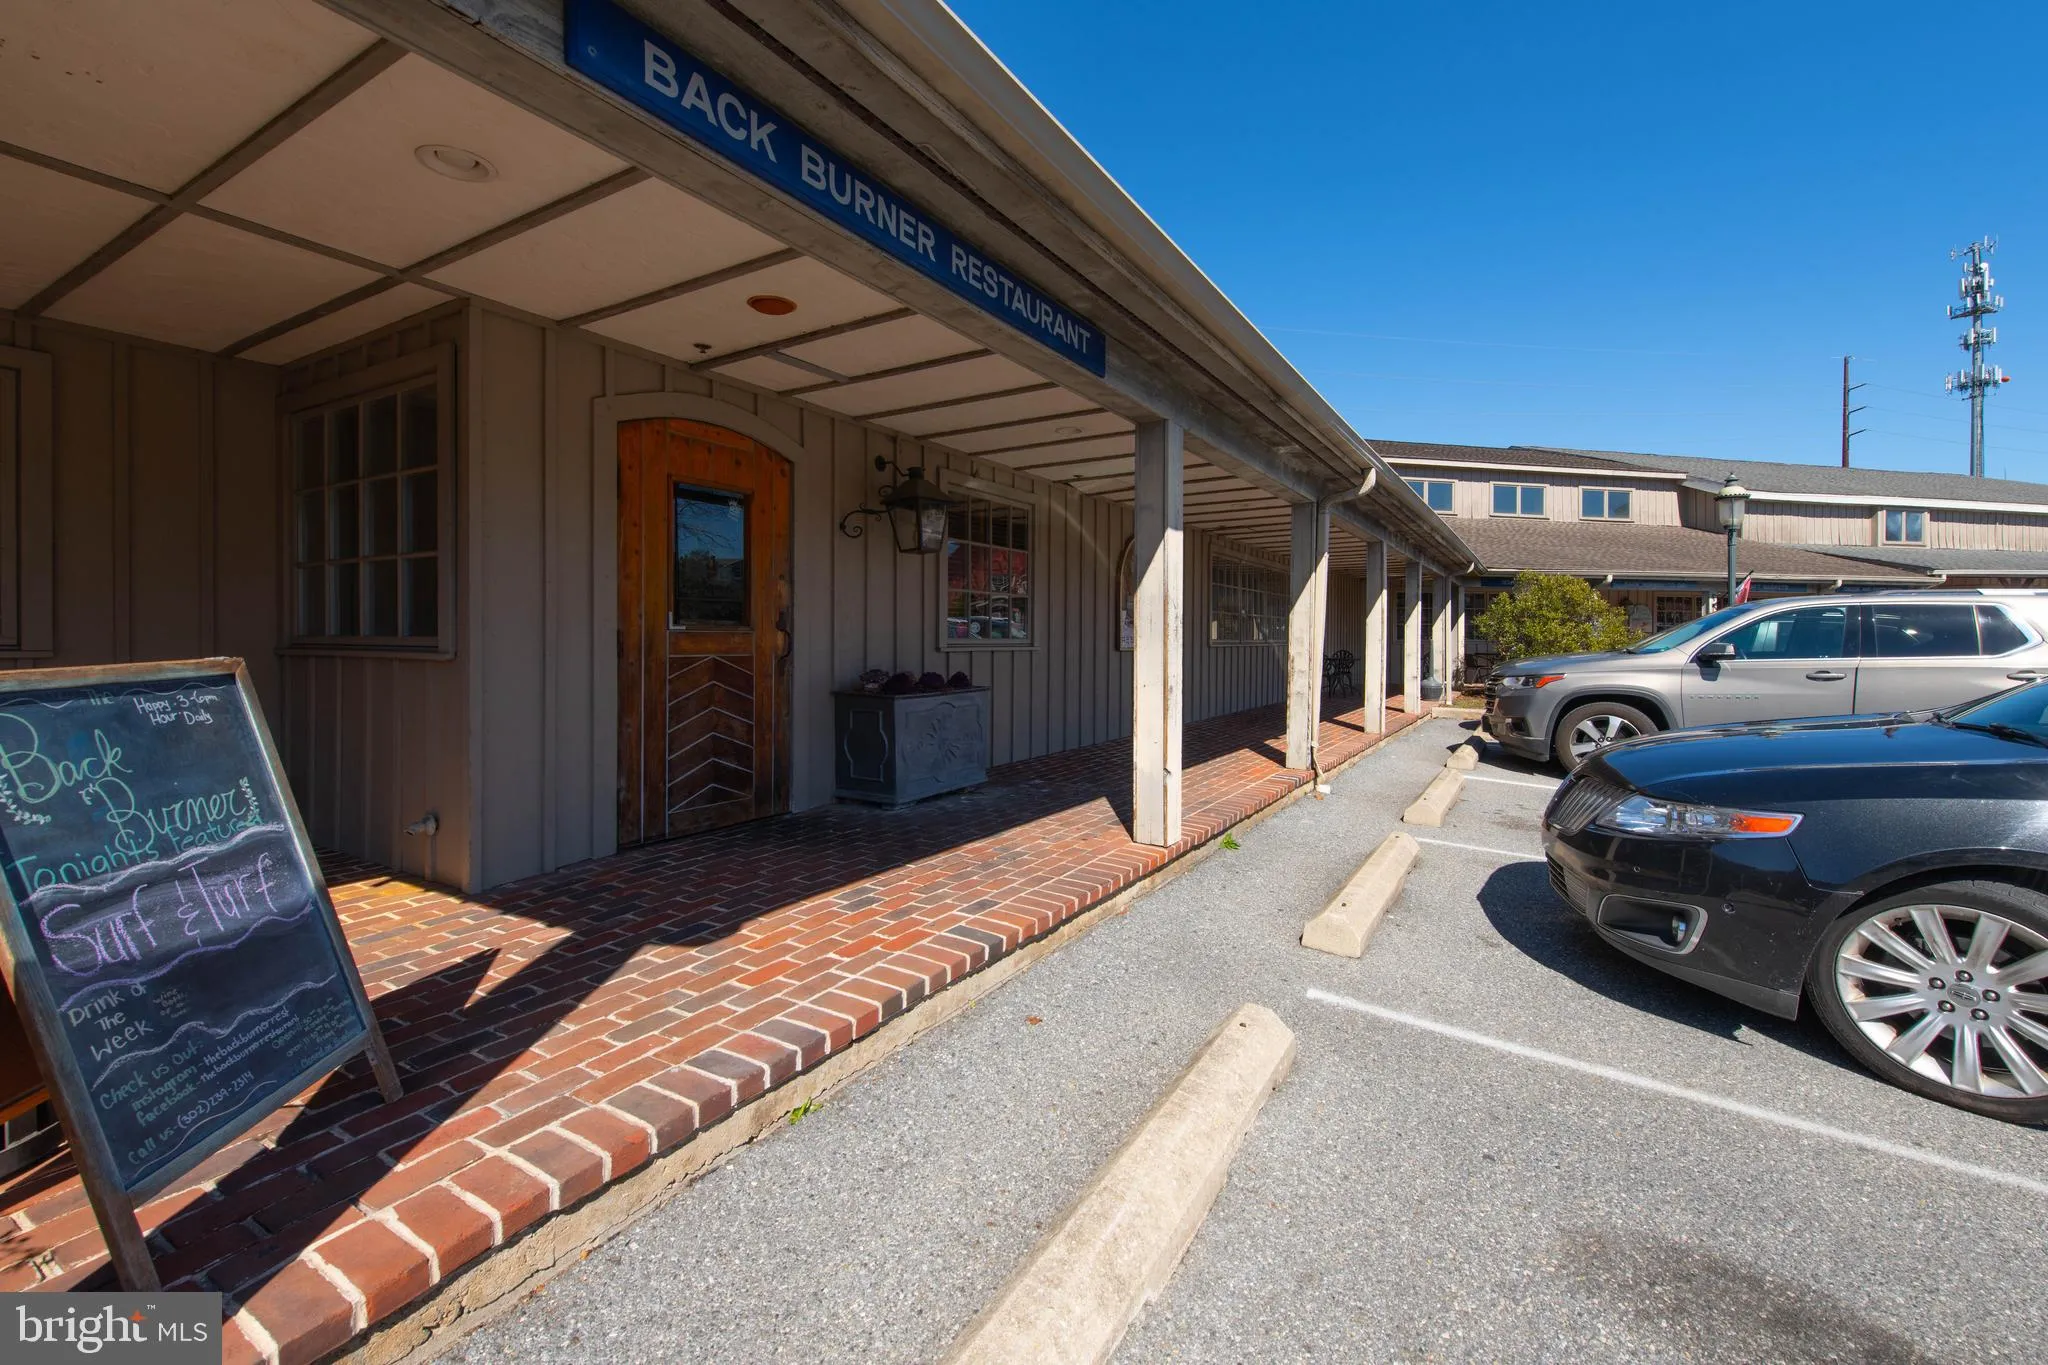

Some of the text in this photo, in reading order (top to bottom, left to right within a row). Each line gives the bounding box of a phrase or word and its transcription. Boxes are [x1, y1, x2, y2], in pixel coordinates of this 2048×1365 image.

[643, 39, 1091, 354] BACK BURNER RESTAURANT
[133, 697, 171, 714] Happy
[150, 709, 213, 726] Hour Daily
[0, 713, 133, 804] Back
[95, 777, 247, 854] Burner
[40, 884, 157, 977] Surf
[179, 852, 280, 932] Turf
[67, 989, 125, 1027] Drink
[95, 1011, 126, 1031] The
[100, 1070, 148, 1110] Check
[152, 1063, 170, 1080] us
[128, 1137, 156, 1165] Call
